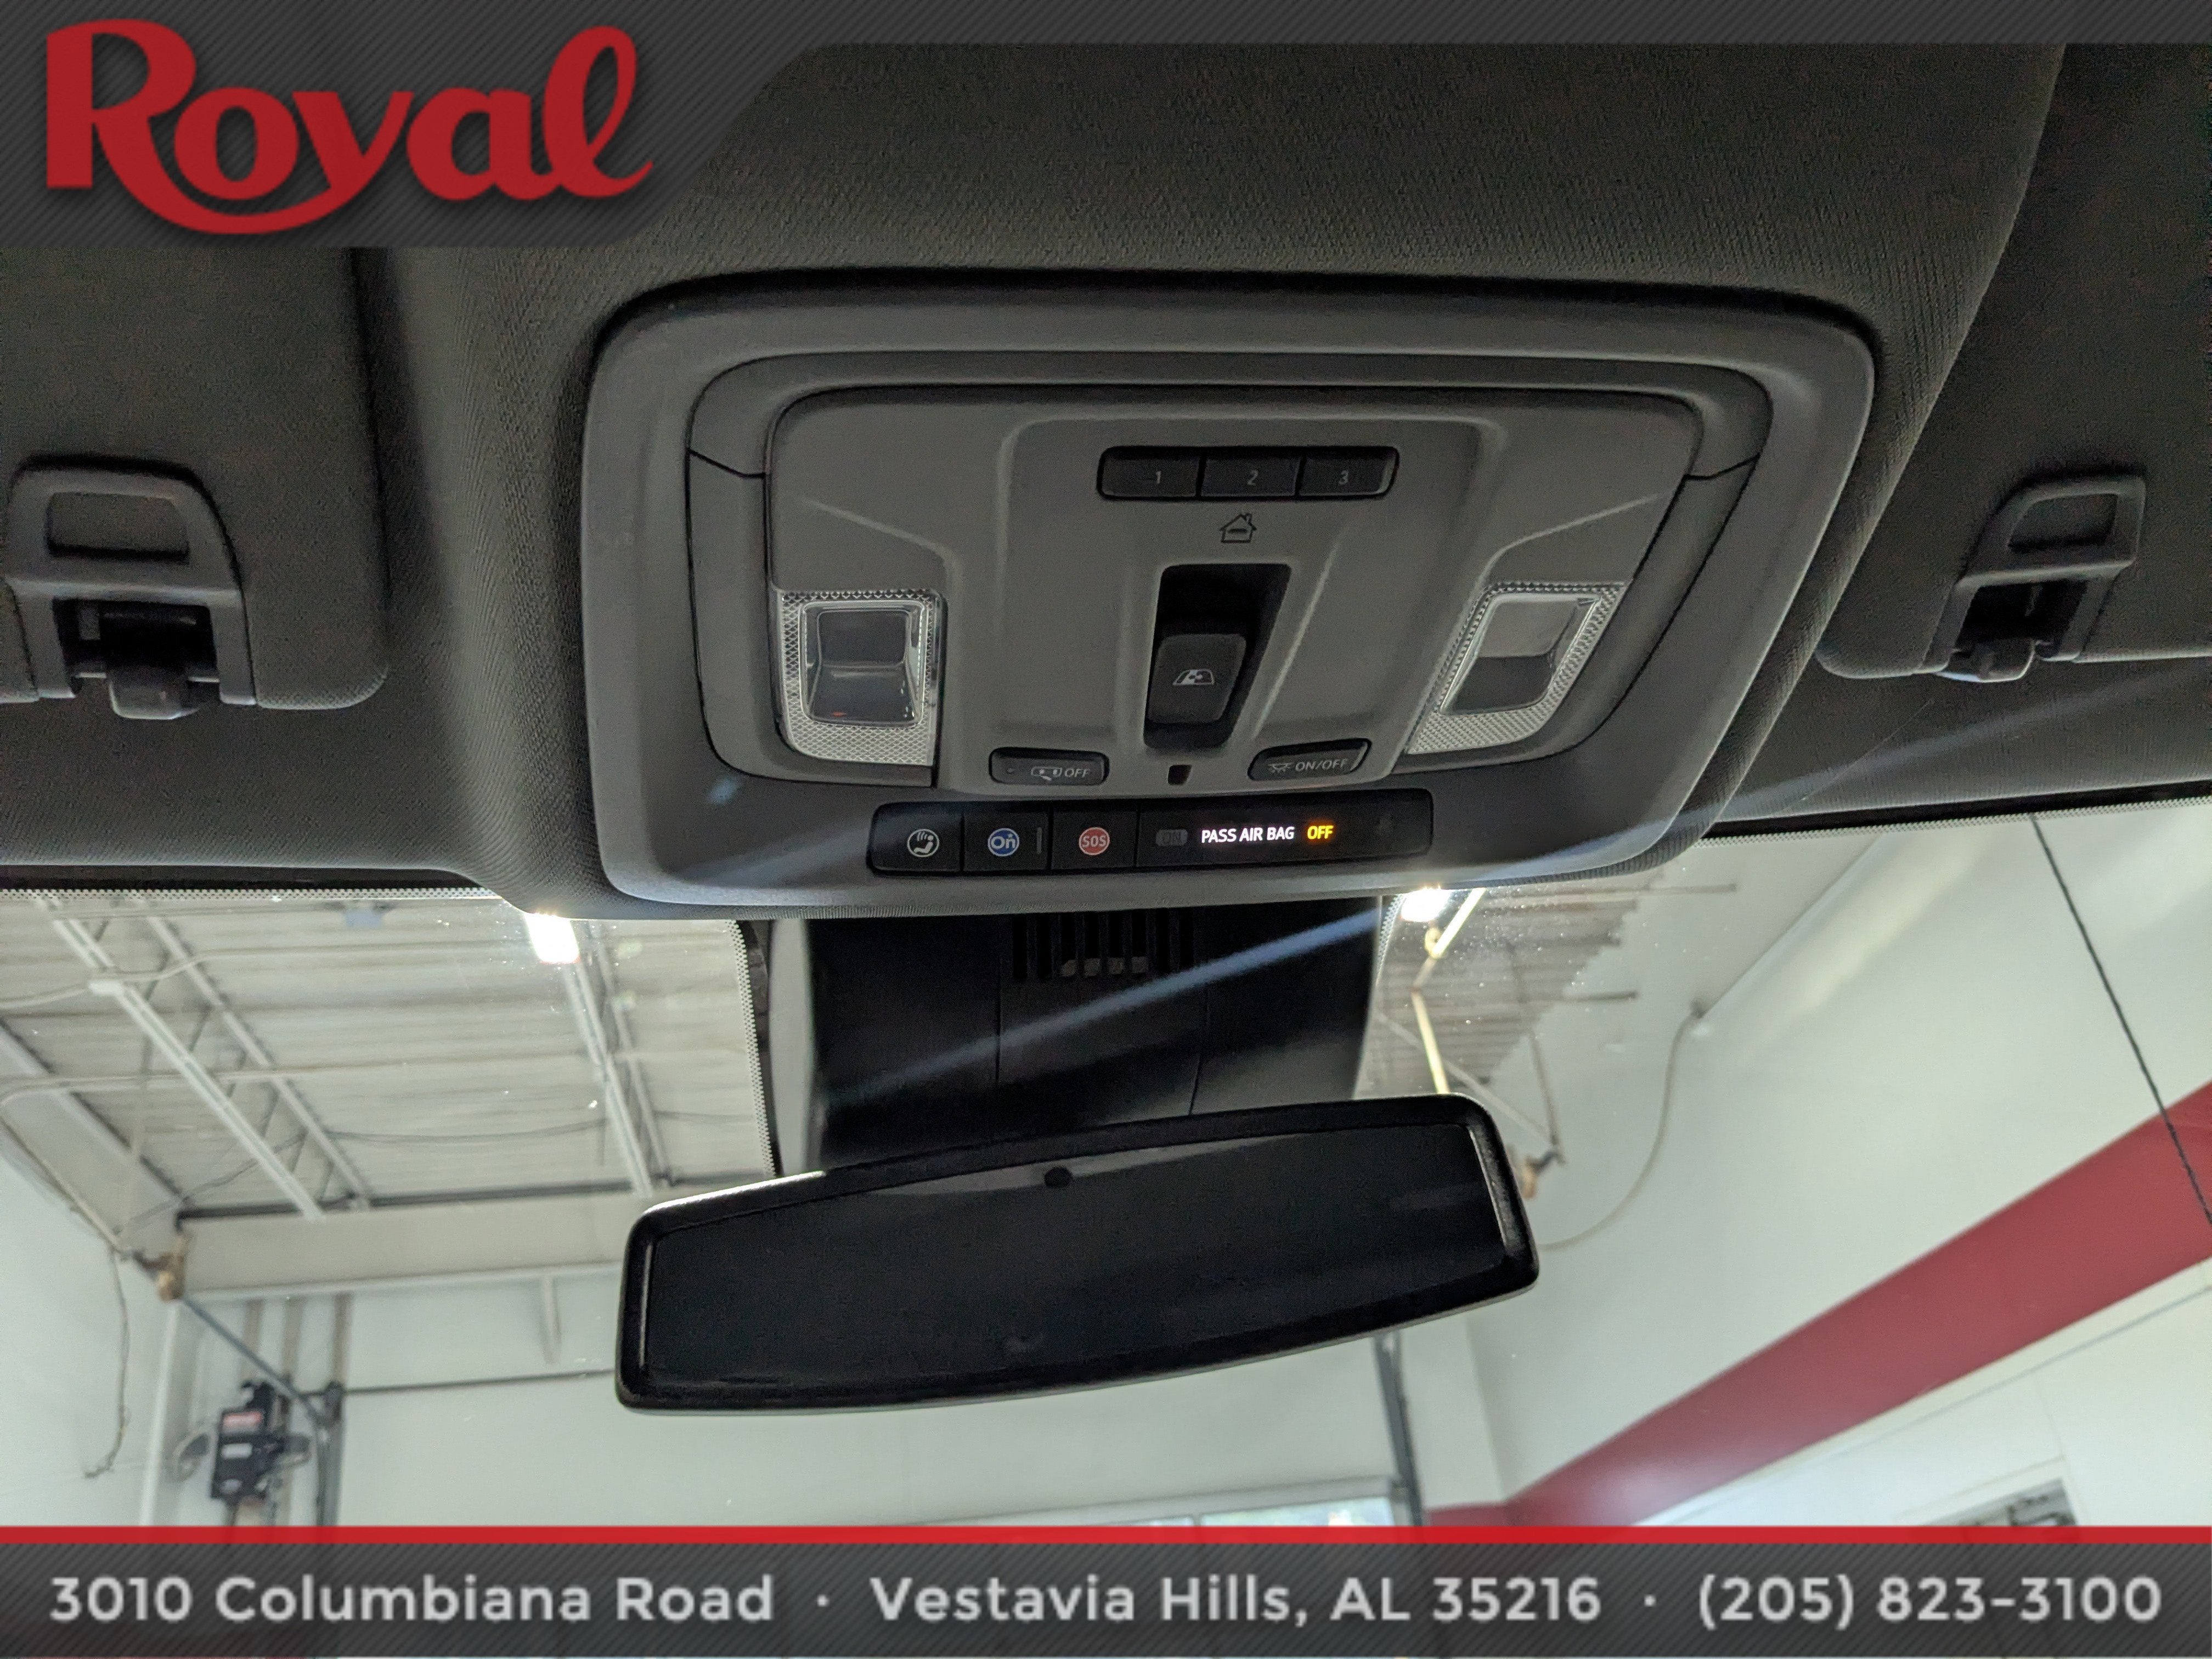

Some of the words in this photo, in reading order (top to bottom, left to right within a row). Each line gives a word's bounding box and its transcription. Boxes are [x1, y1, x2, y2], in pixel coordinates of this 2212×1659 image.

[1155, 471, 1161, 484] 1
[1247, 470, 1259, 486] 2
[1339, 470, 1349, 485] 3
[1295, 759, 1348, 772] ON/OFF
[1064, 768, 1091, 778] OFF
[1201, 828, 1237, 843] PASS
[1239, 827, 1263, 842] AIR
[1266, 826, 1295, 840] BAG
[1307, 825, 1334, 839] OFF
[991, 834, 1016, 849] On
[1083, 835, 1106, 848] SOS
